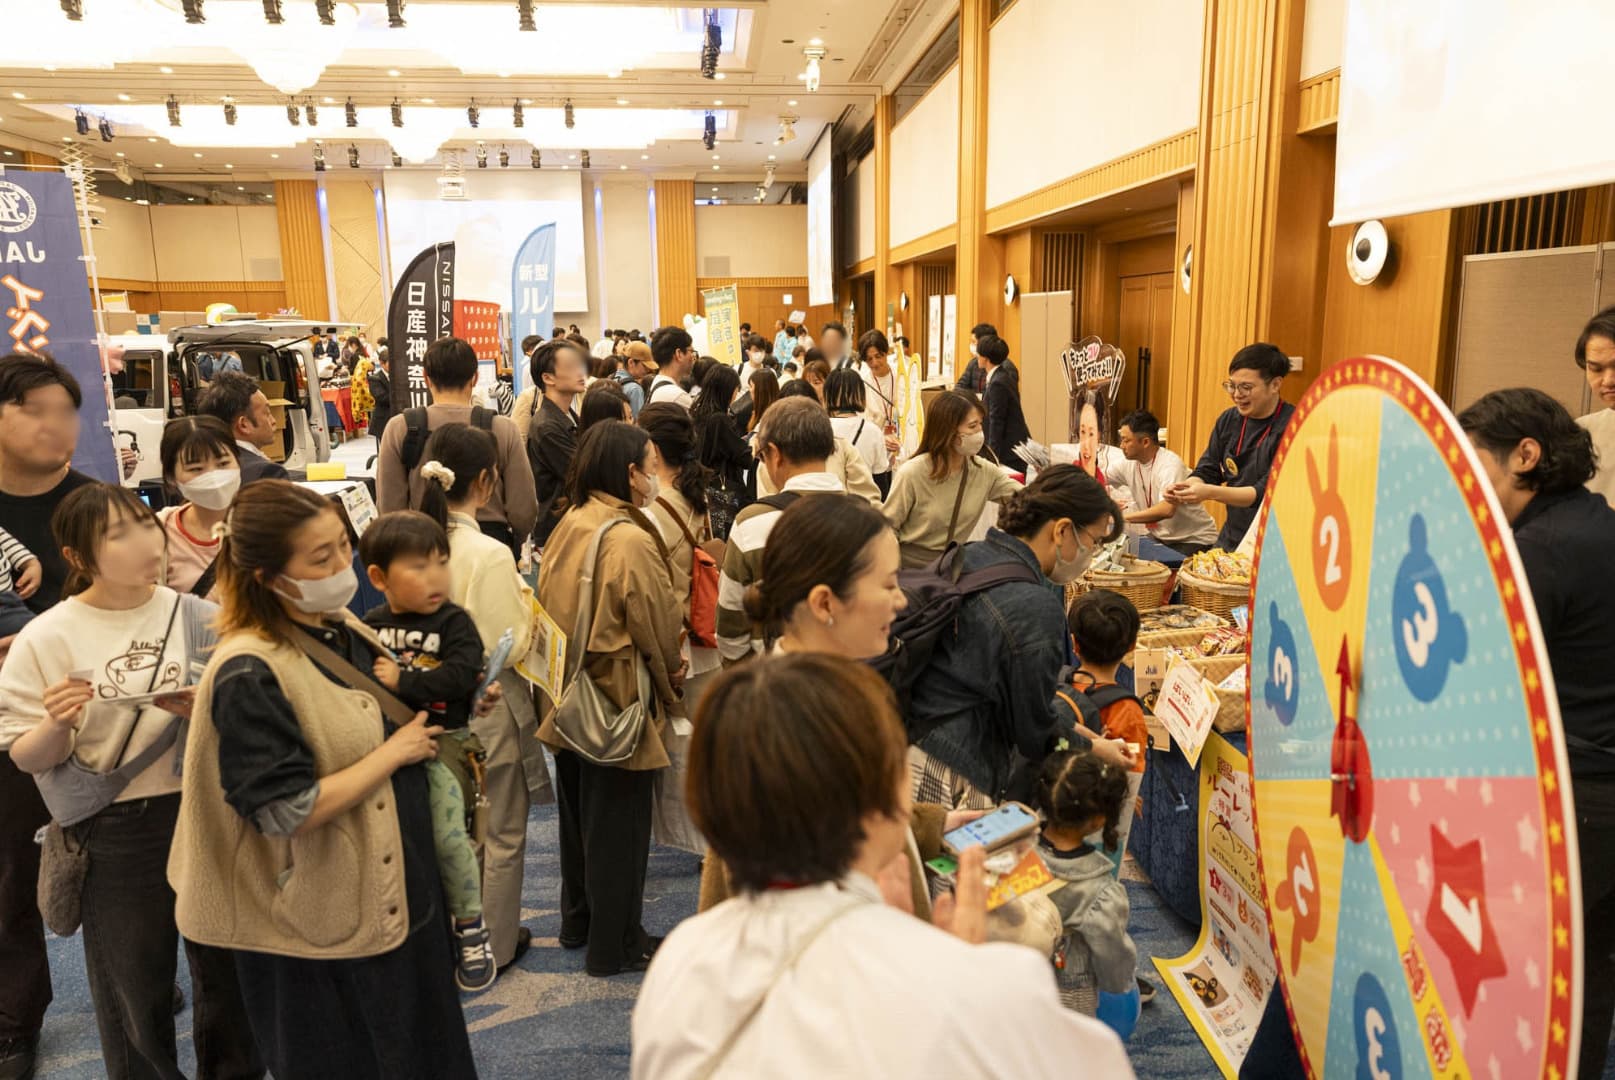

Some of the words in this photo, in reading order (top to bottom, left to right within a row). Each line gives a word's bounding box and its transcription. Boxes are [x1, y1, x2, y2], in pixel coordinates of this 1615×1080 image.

[519, 263, 548, 283] 新型
[406, 281, 428, 408] 日産神奈川
[1319, 515, 1341, 585] 2
[373, 628, 441, 653] MICA
[1402, 582, 1439, 668] 3
[1274, 646, 1293, 701] 3
[1293, 850, 1314, 917] 2
[1441, 881, 1482, 955] 1
